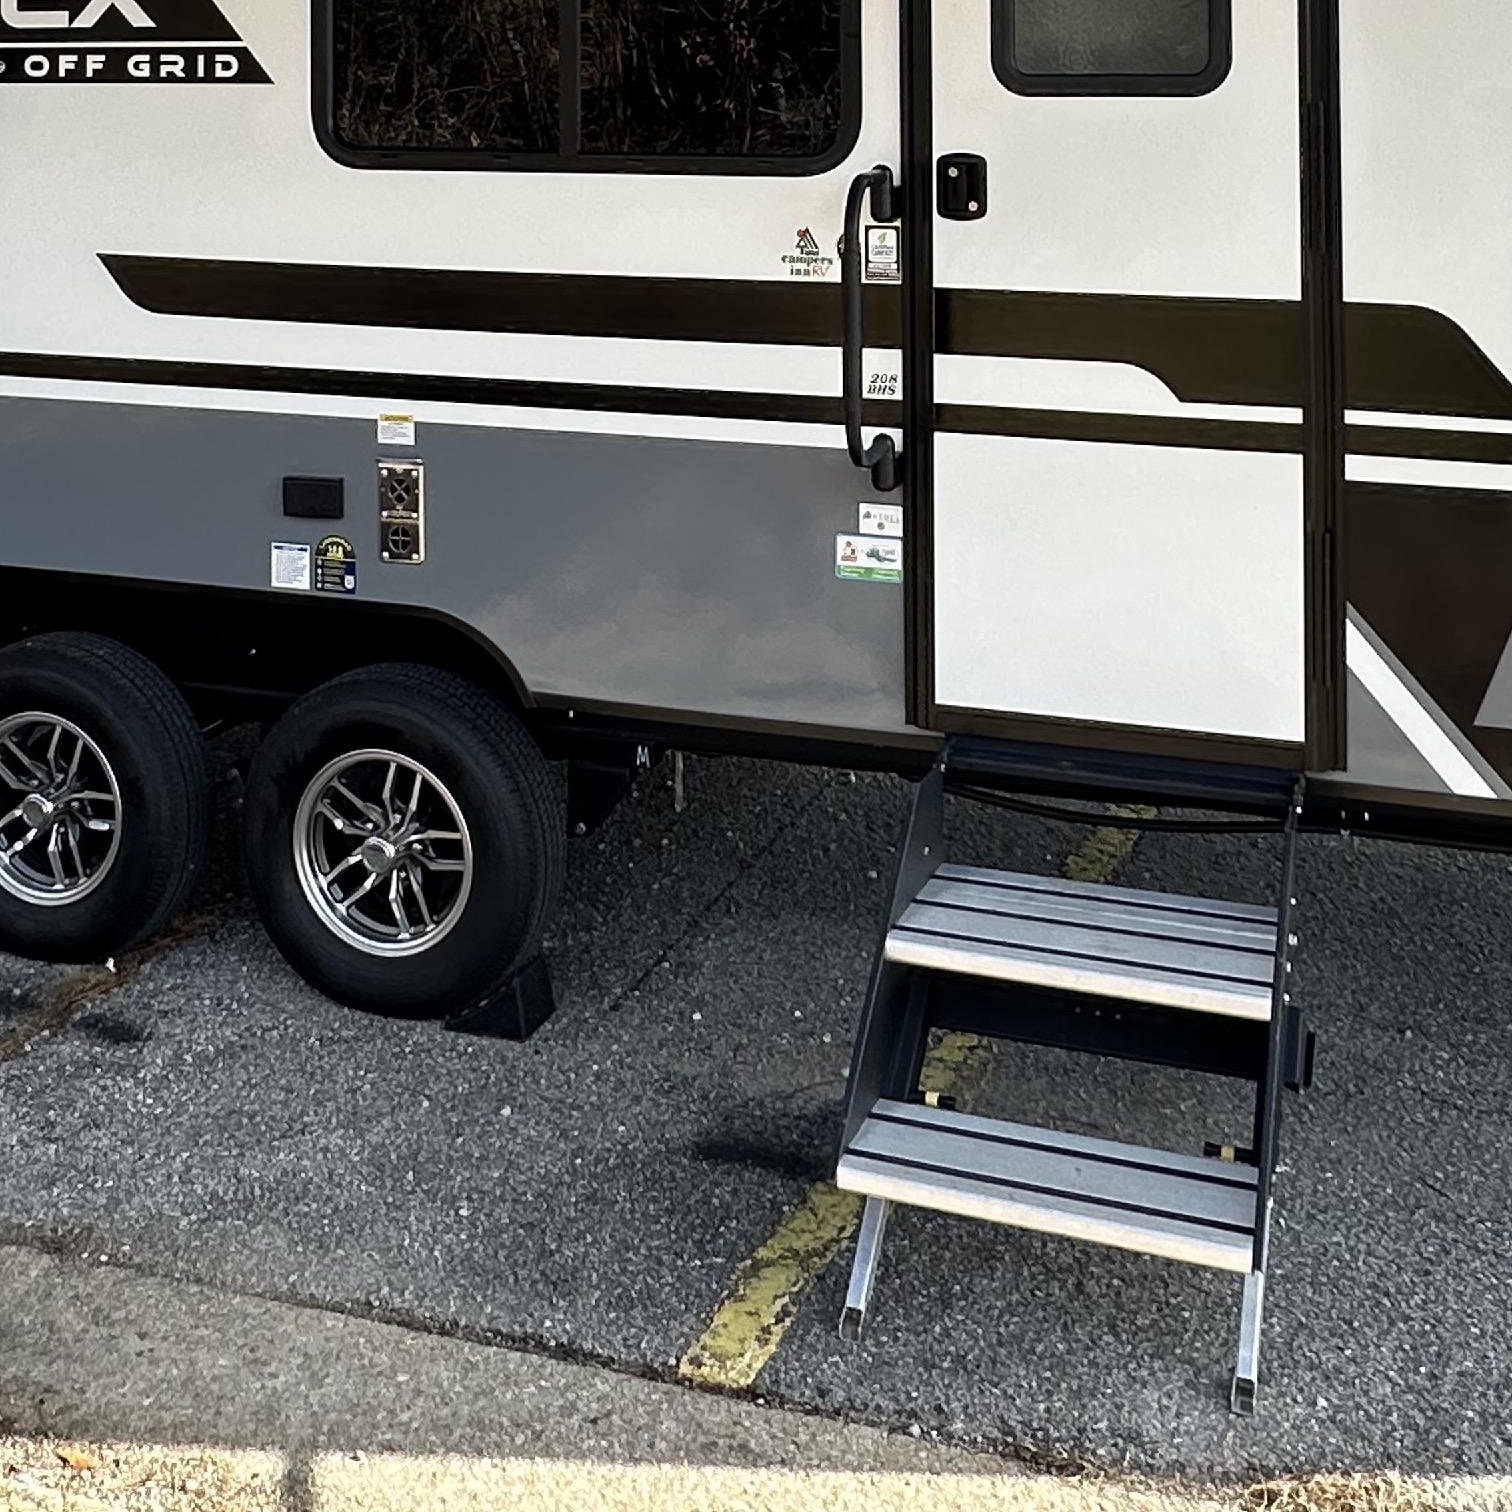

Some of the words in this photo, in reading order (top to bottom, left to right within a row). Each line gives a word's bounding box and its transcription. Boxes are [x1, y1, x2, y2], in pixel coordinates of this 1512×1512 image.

[23, 54, 107, 78] OFF
[126, 54, 240, 78] GRID
[812, 265, 831, 277] RV
[870, 373, 898, 384] 208
[867, 384, 897, 395] BHS
